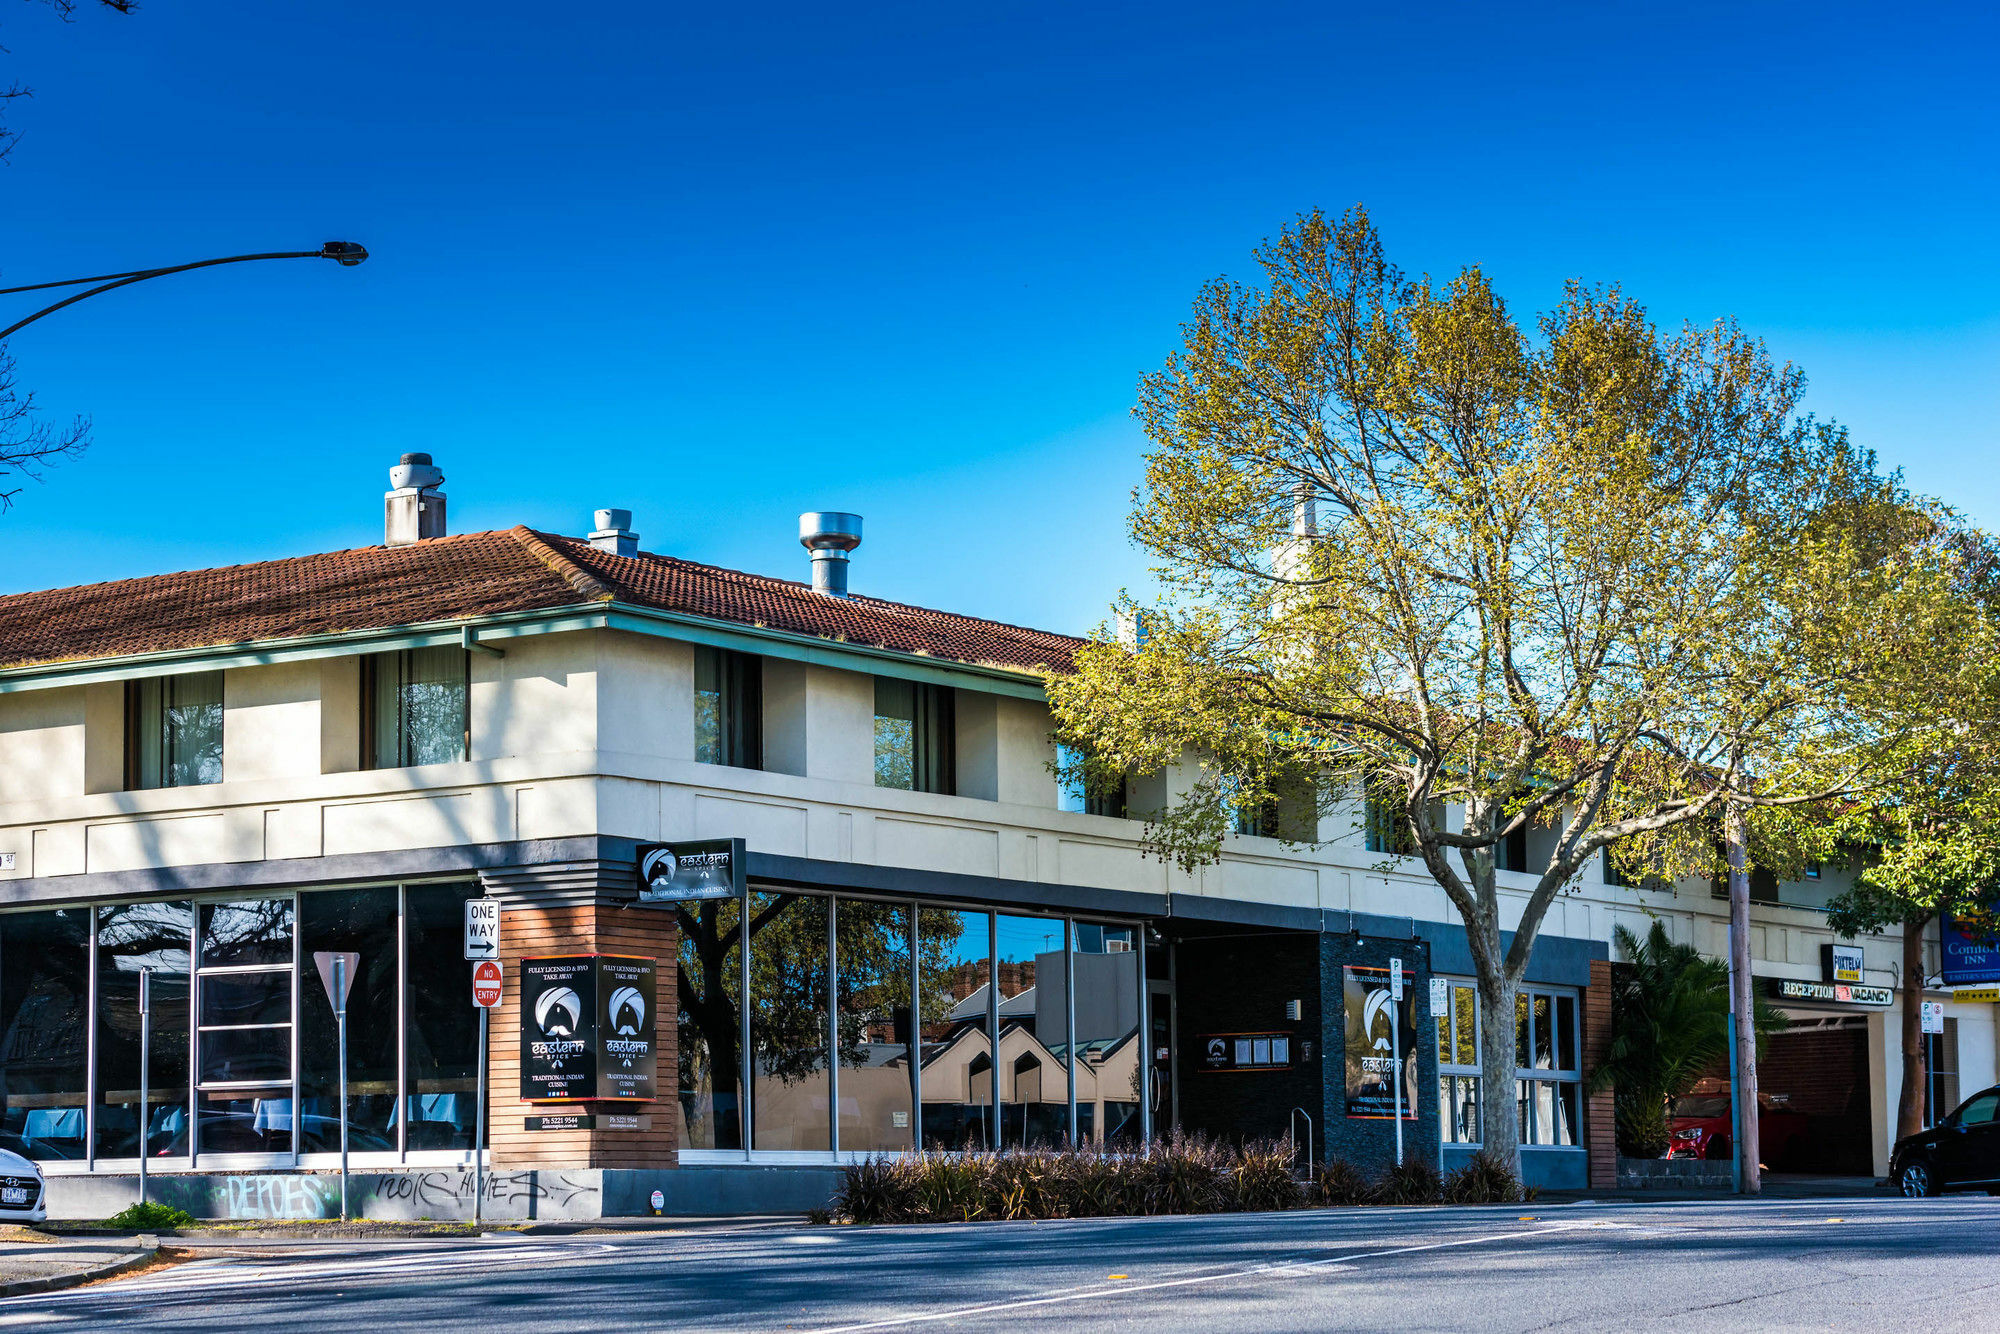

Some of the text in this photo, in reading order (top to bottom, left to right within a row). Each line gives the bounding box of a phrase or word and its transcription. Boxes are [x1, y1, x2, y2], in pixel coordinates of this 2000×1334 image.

[680, 850, 729, 866] eastern
[471, 906, 494, 918] ONE
[469, 924, 496, 936] WAY
[1834, 955, 1855, 972] FOXTEL
[1964, 955, 1986, 964] INN
[484, 970, 494, 978] NO
[478, 990, 498, 1000] ENTRY
[1783, 982, 1834, 998] RECEPTION
[1851, 988, 1889, 1002] VACANCY
[531, 1037, 585, 1054] eastern
[606, 1037, 648, 1053] eastern
